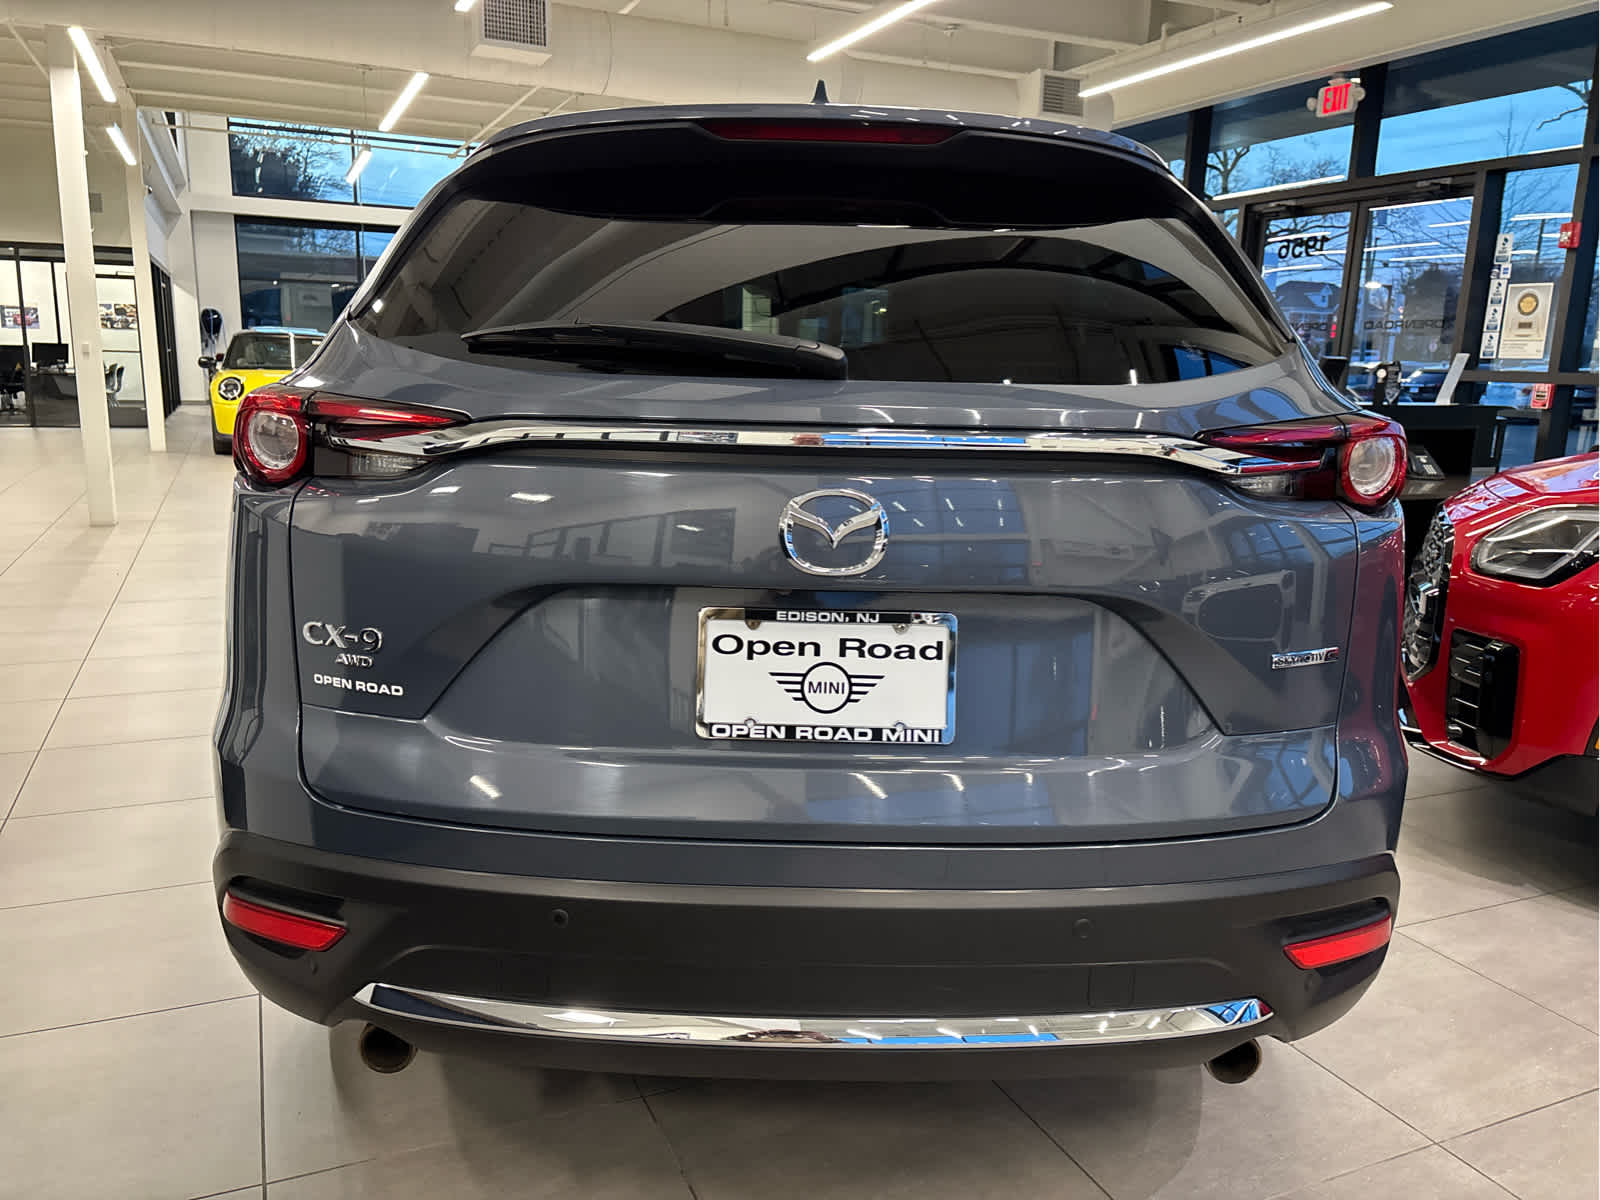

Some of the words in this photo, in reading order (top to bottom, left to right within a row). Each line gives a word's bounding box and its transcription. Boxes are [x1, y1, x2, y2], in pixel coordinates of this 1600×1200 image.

[1322, 83, 1352, 114] EXIT
[776, 610, 849, 623] EDISON,
[856, 613, 880, 624] NJ
[302, 621, 383, 652] CX-9
[711, 634, 821, 661] Open
[839, 637, 943, 661] Road
[335, 653, 373, 667] AWD
[313, 673, 352, 690] OPEN
[355, 680, 404, 696] ROAD
[807, 681, 845, 695] MINI
[711, 723, 785, 739] OPEN
[795, 726, 874, 741] ROAD
[881, 728, 940, 743] MINI
